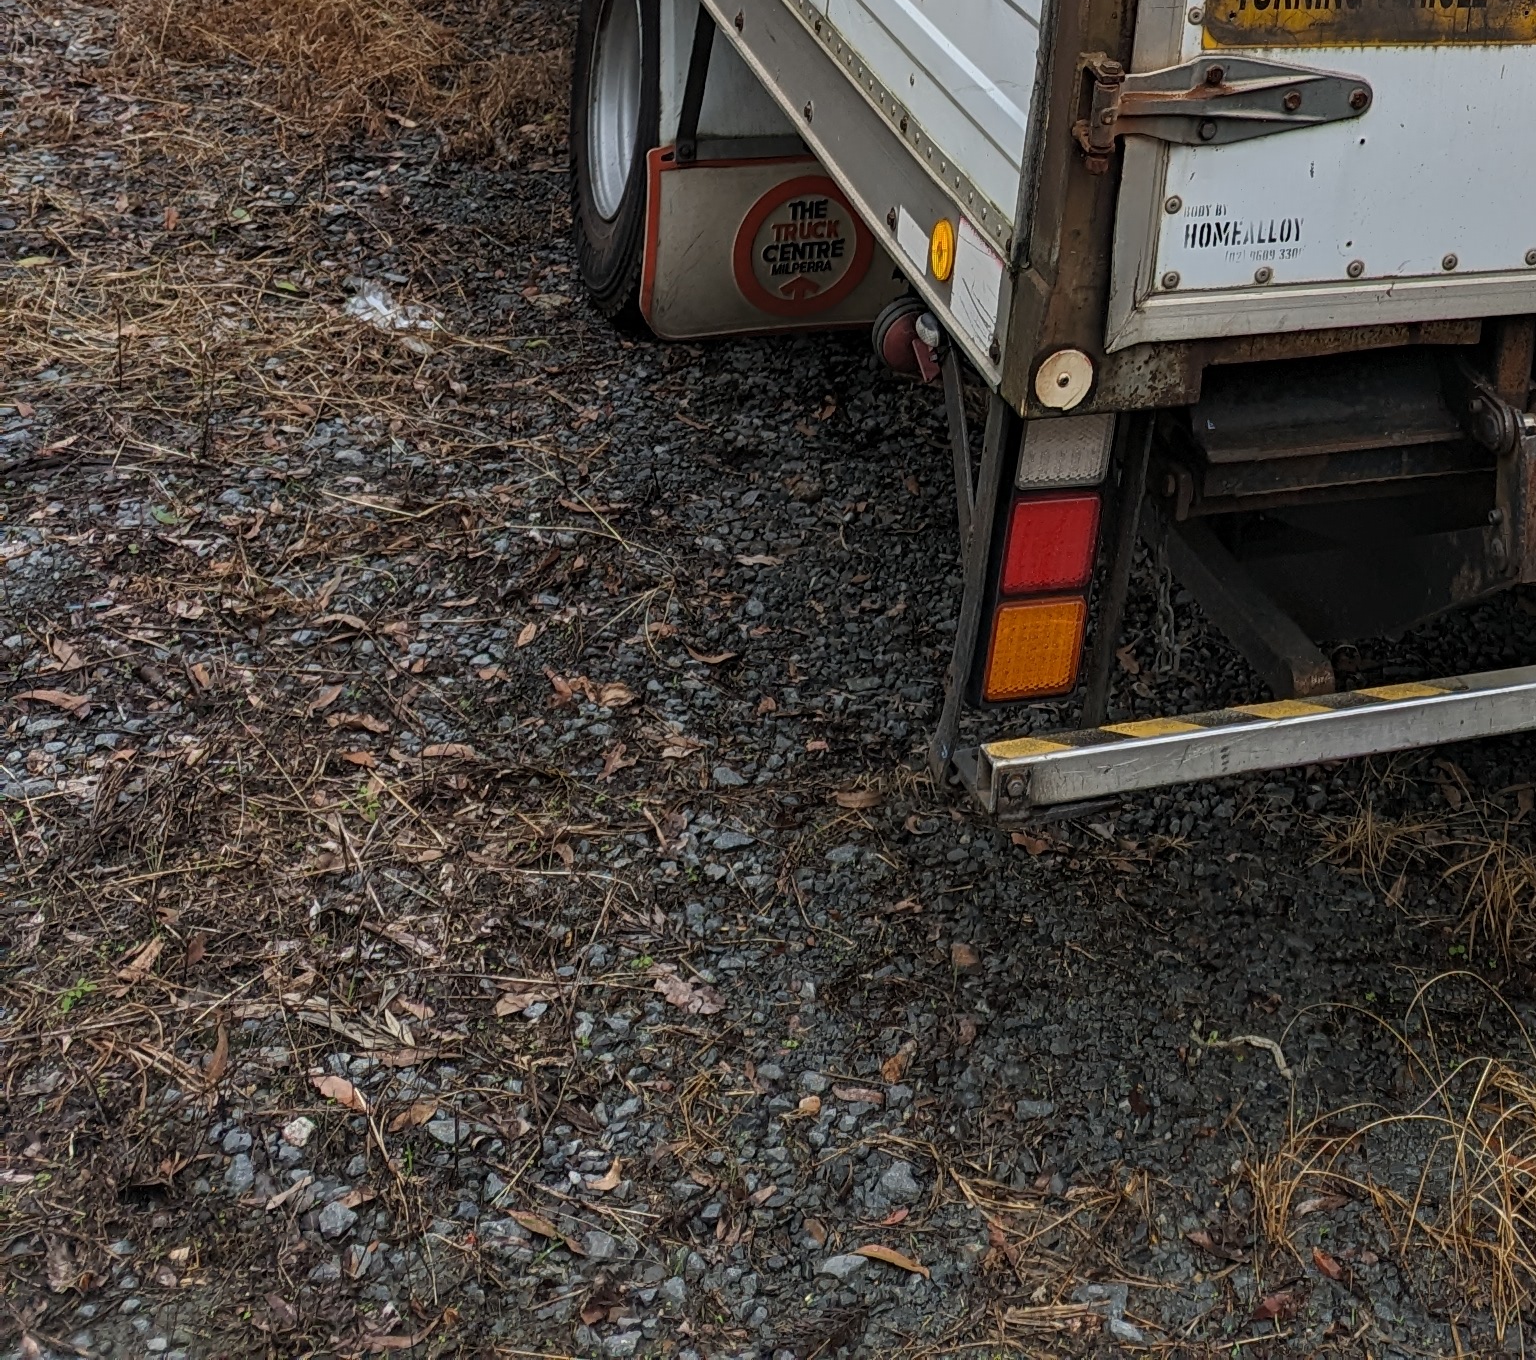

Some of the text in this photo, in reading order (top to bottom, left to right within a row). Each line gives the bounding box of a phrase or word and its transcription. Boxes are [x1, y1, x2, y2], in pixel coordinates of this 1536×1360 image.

[788, 199, 829, 221] THE
[771, 220, 840, 242] TRUCK
[1184, 217, 1304, 249] HOMEALLOY
[761, 238, 846, 263] CENTRE
[770, 260, 832, 276] MILPERRA
